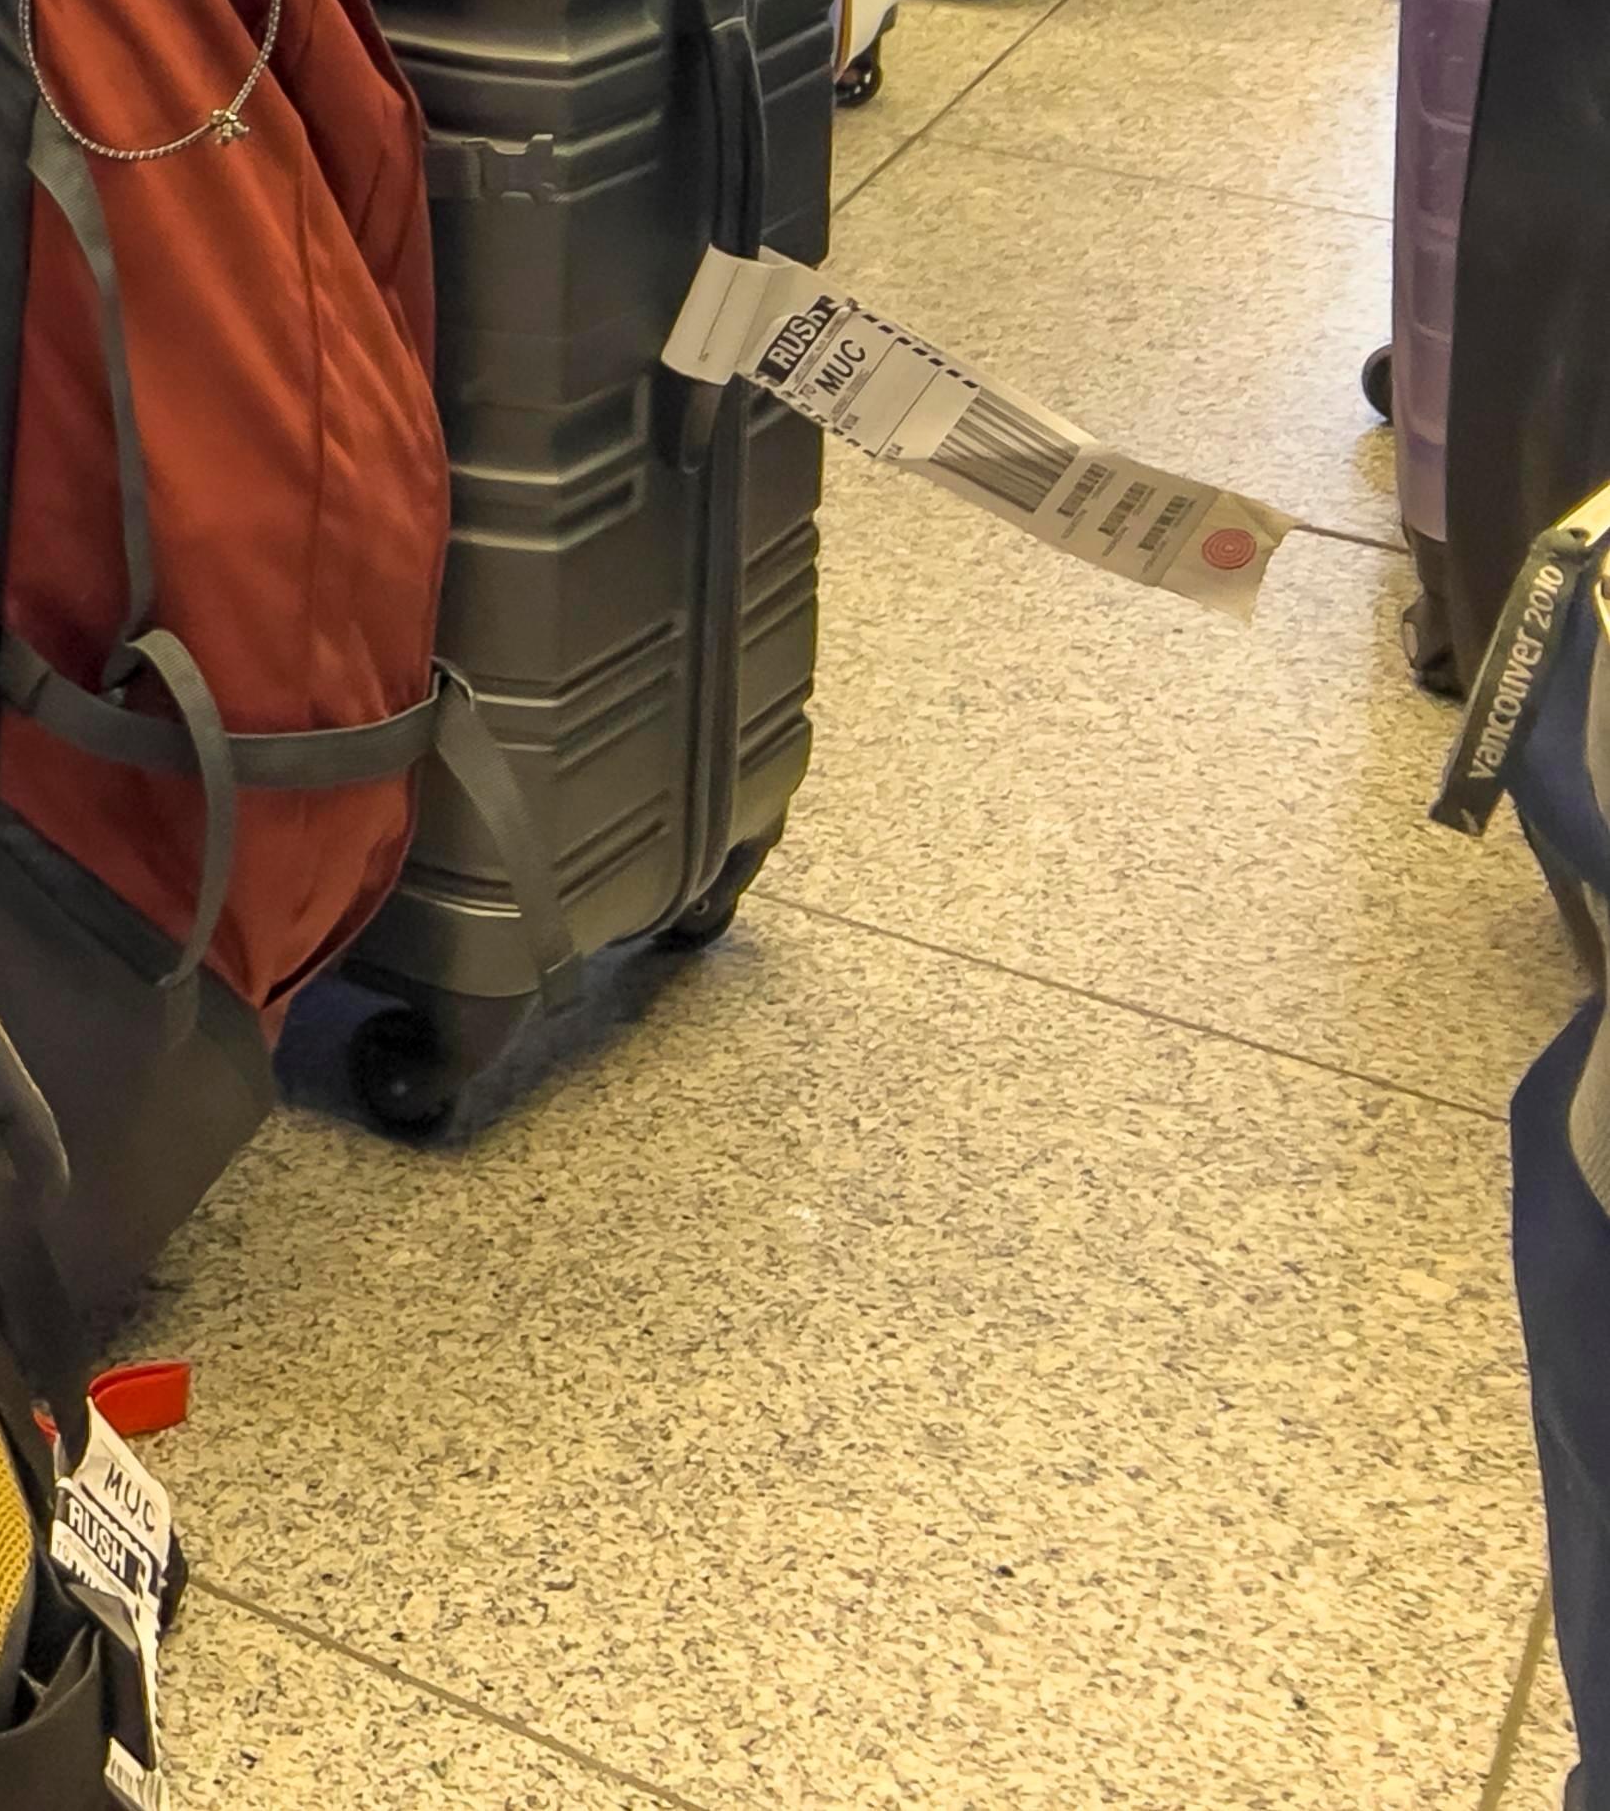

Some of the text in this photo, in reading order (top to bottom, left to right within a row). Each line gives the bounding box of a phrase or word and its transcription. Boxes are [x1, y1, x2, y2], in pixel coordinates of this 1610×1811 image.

[814, 339, 867, 397] MUC
[1524, 564, 1565, 630] 2010
[67, 1496, 127, 1580] RUSH
